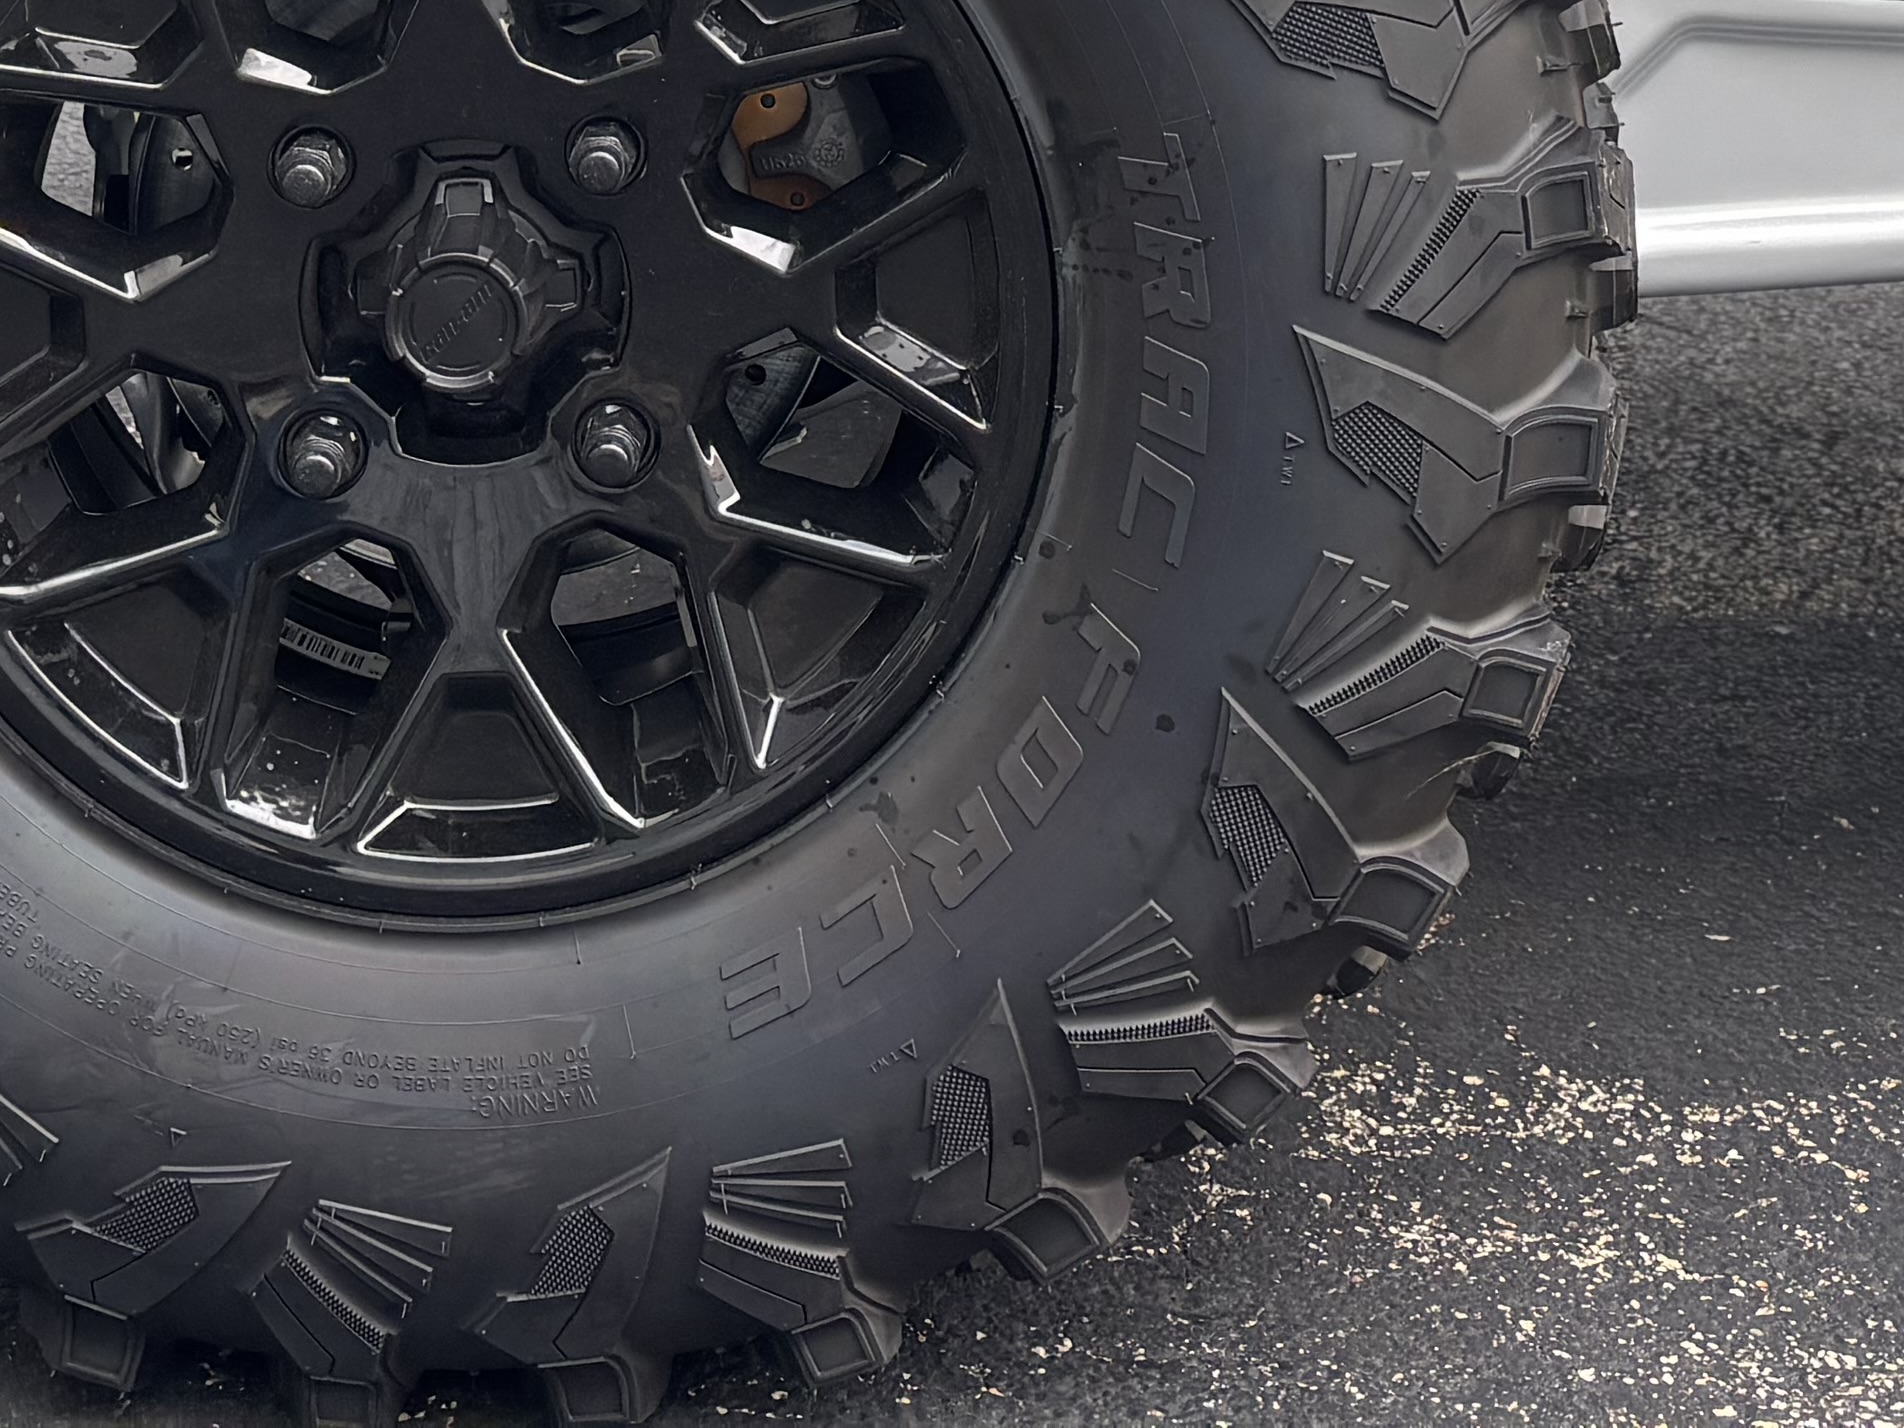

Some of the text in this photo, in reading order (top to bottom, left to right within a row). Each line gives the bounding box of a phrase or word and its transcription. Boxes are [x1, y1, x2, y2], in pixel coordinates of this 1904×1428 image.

[718, 130, 1213, 1041] TRAC FORCE
[30, 933, 104, 984] SEATING
[23, 952, 121, 1016] OPERATING
[129, 1010, 168, 1037] FOR
[177, 1026, 249, 1066] MANUAL
[563, 1045, 591, 1063] DO
[257, 1054, 343, 1087] OWNER'S
[342, 1049, 417, 1073] BEYOND
[427, 1055, 505, 1073] INFLATE
[516, 1052, 554, 1070] NOT
[353, 1069, 380, 1090] OR
[391, 1074, 452, 1094] LABEL
[462, 1072, 547, 1093] VEHICLE
[557, 1063, 594, 1087] SEE
[470, 1084, 599, 1119] WARNING:
